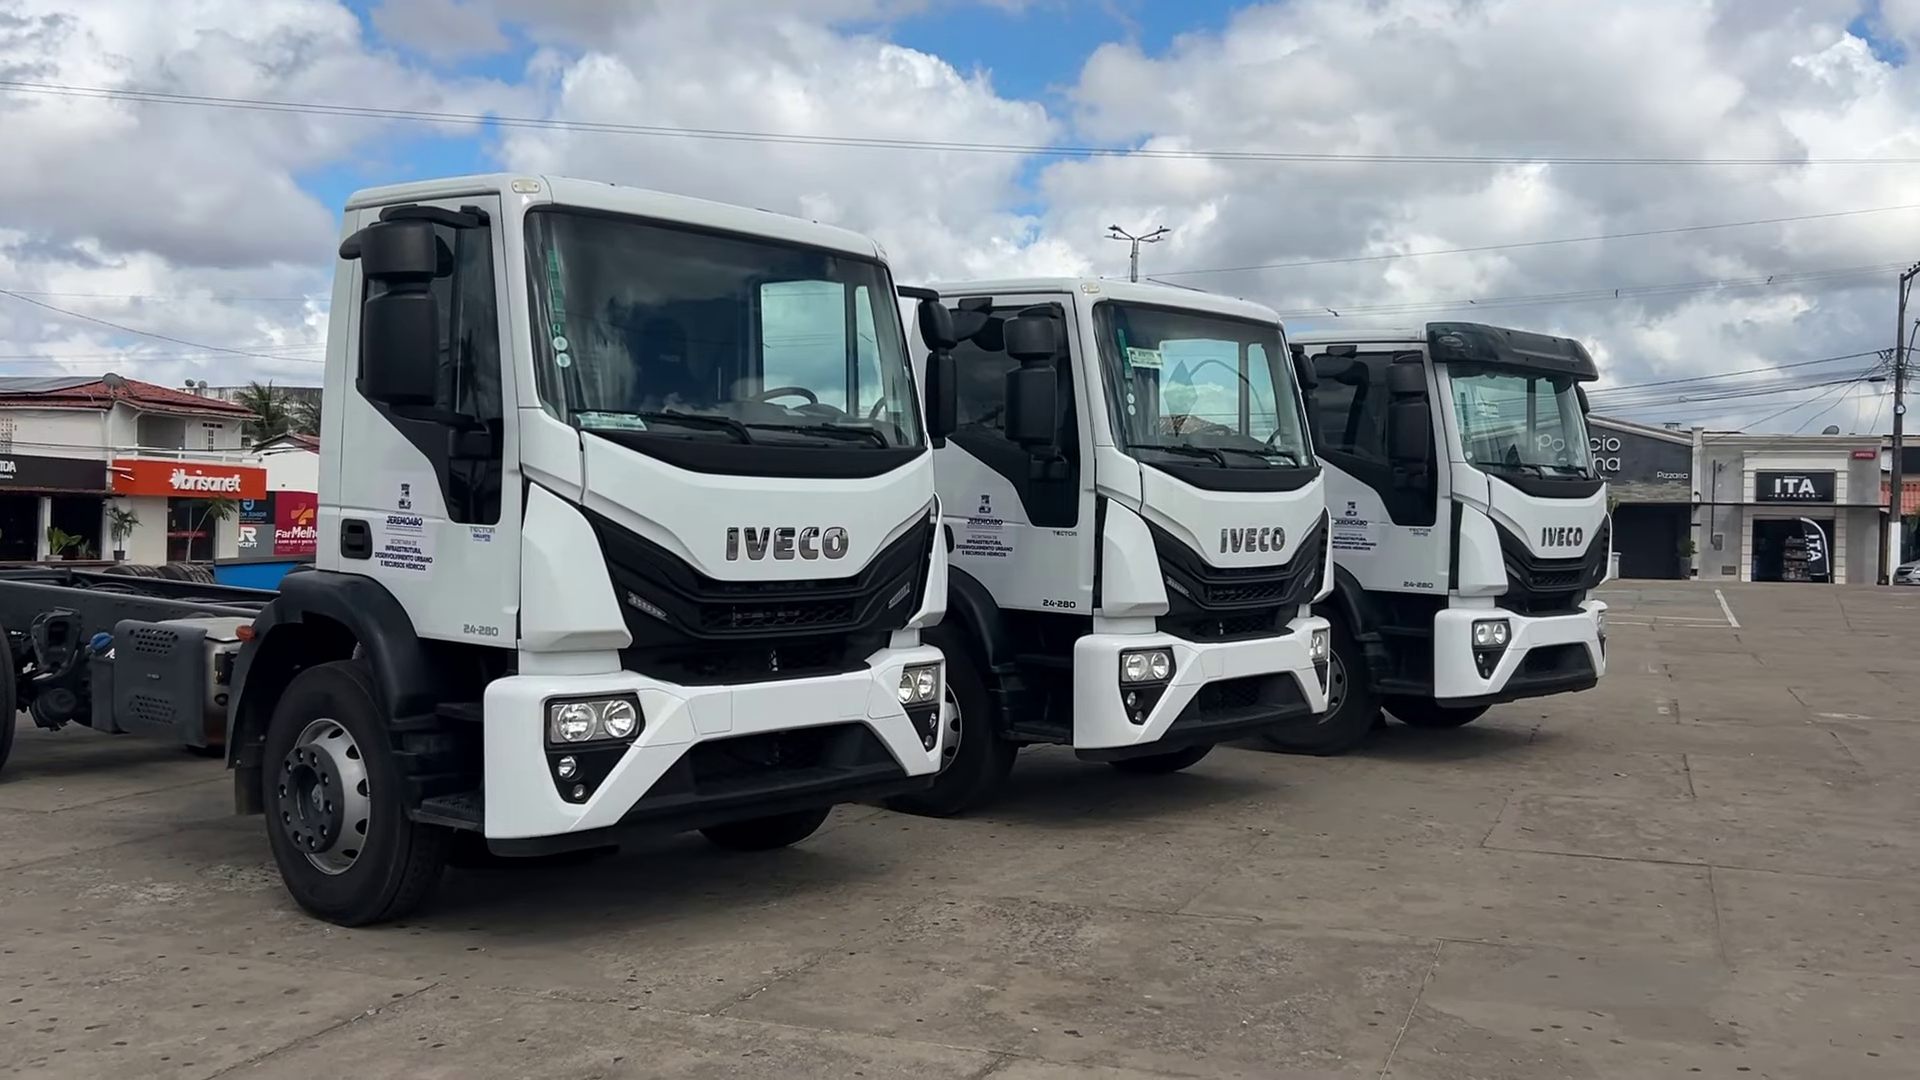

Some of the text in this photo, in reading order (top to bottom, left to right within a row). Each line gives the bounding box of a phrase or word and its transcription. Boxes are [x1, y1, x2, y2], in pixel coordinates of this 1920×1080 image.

[180, 468, 241, 492] brisanet
[1656, 470, 1689, 480] Pizzaria
[1774, 478, 1816, 494] ITA
[386, 515, 423, 526] JEREMOABO
[275, 526, 318, 538] FarMelh
[1541, 527, 1584, 547] IVECO
[725, 526, 849, 562] IVECO
[1219, 526, 1286, 554] IVECO
[1807, 534, 1822, 562] ITA
[375, 552, 433, 564] DESENVOLVIMENTO URBANO
[384, 560, 405, 568] RECURSOS
[1403, 581, 1434, 589] 24-280
[1042, 599, 1077, 609] 24-280
[463, 623, 499, 636] 24-280
